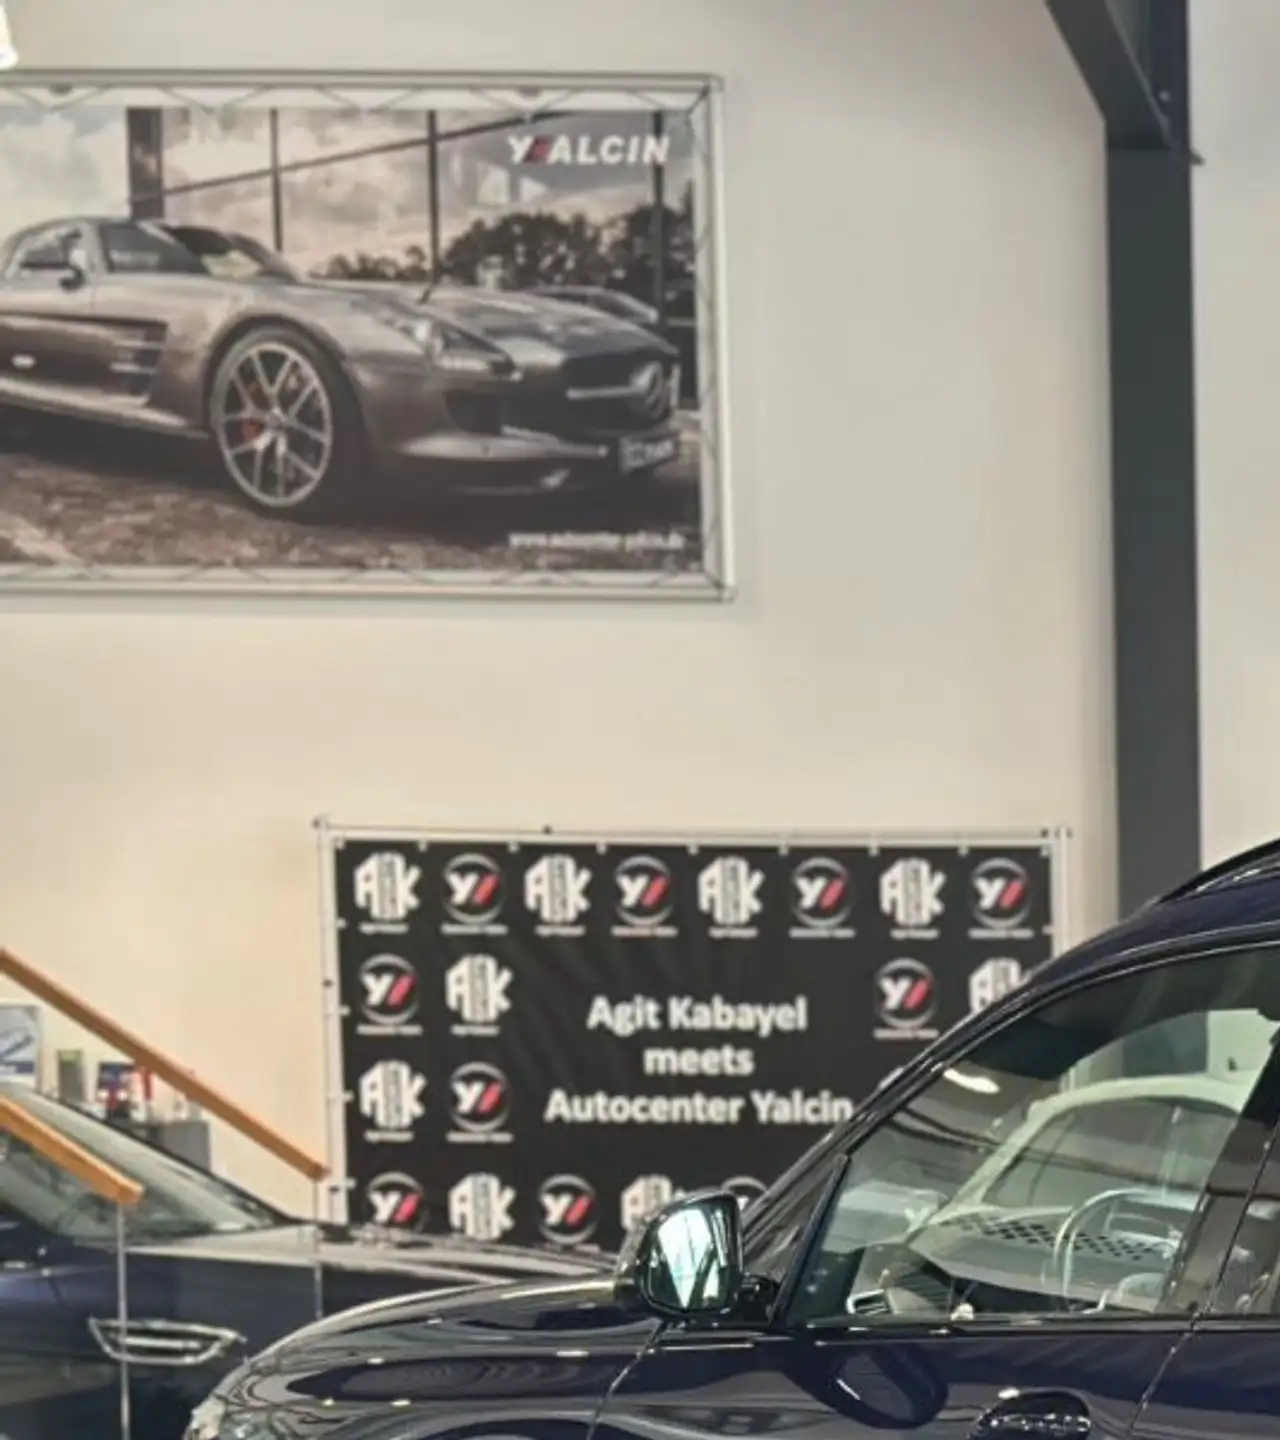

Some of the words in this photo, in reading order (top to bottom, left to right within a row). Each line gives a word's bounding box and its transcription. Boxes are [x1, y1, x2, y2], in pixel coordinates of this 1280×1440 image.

[587, 994, 661, 1037] Agit
[668, 994, 808, 1037] Kabayel
[643, 1044, 755, 1075] meets
[544, 1089, 746, 1123] Autocenter
[750, 1088, 853, 1124] Yalcin
